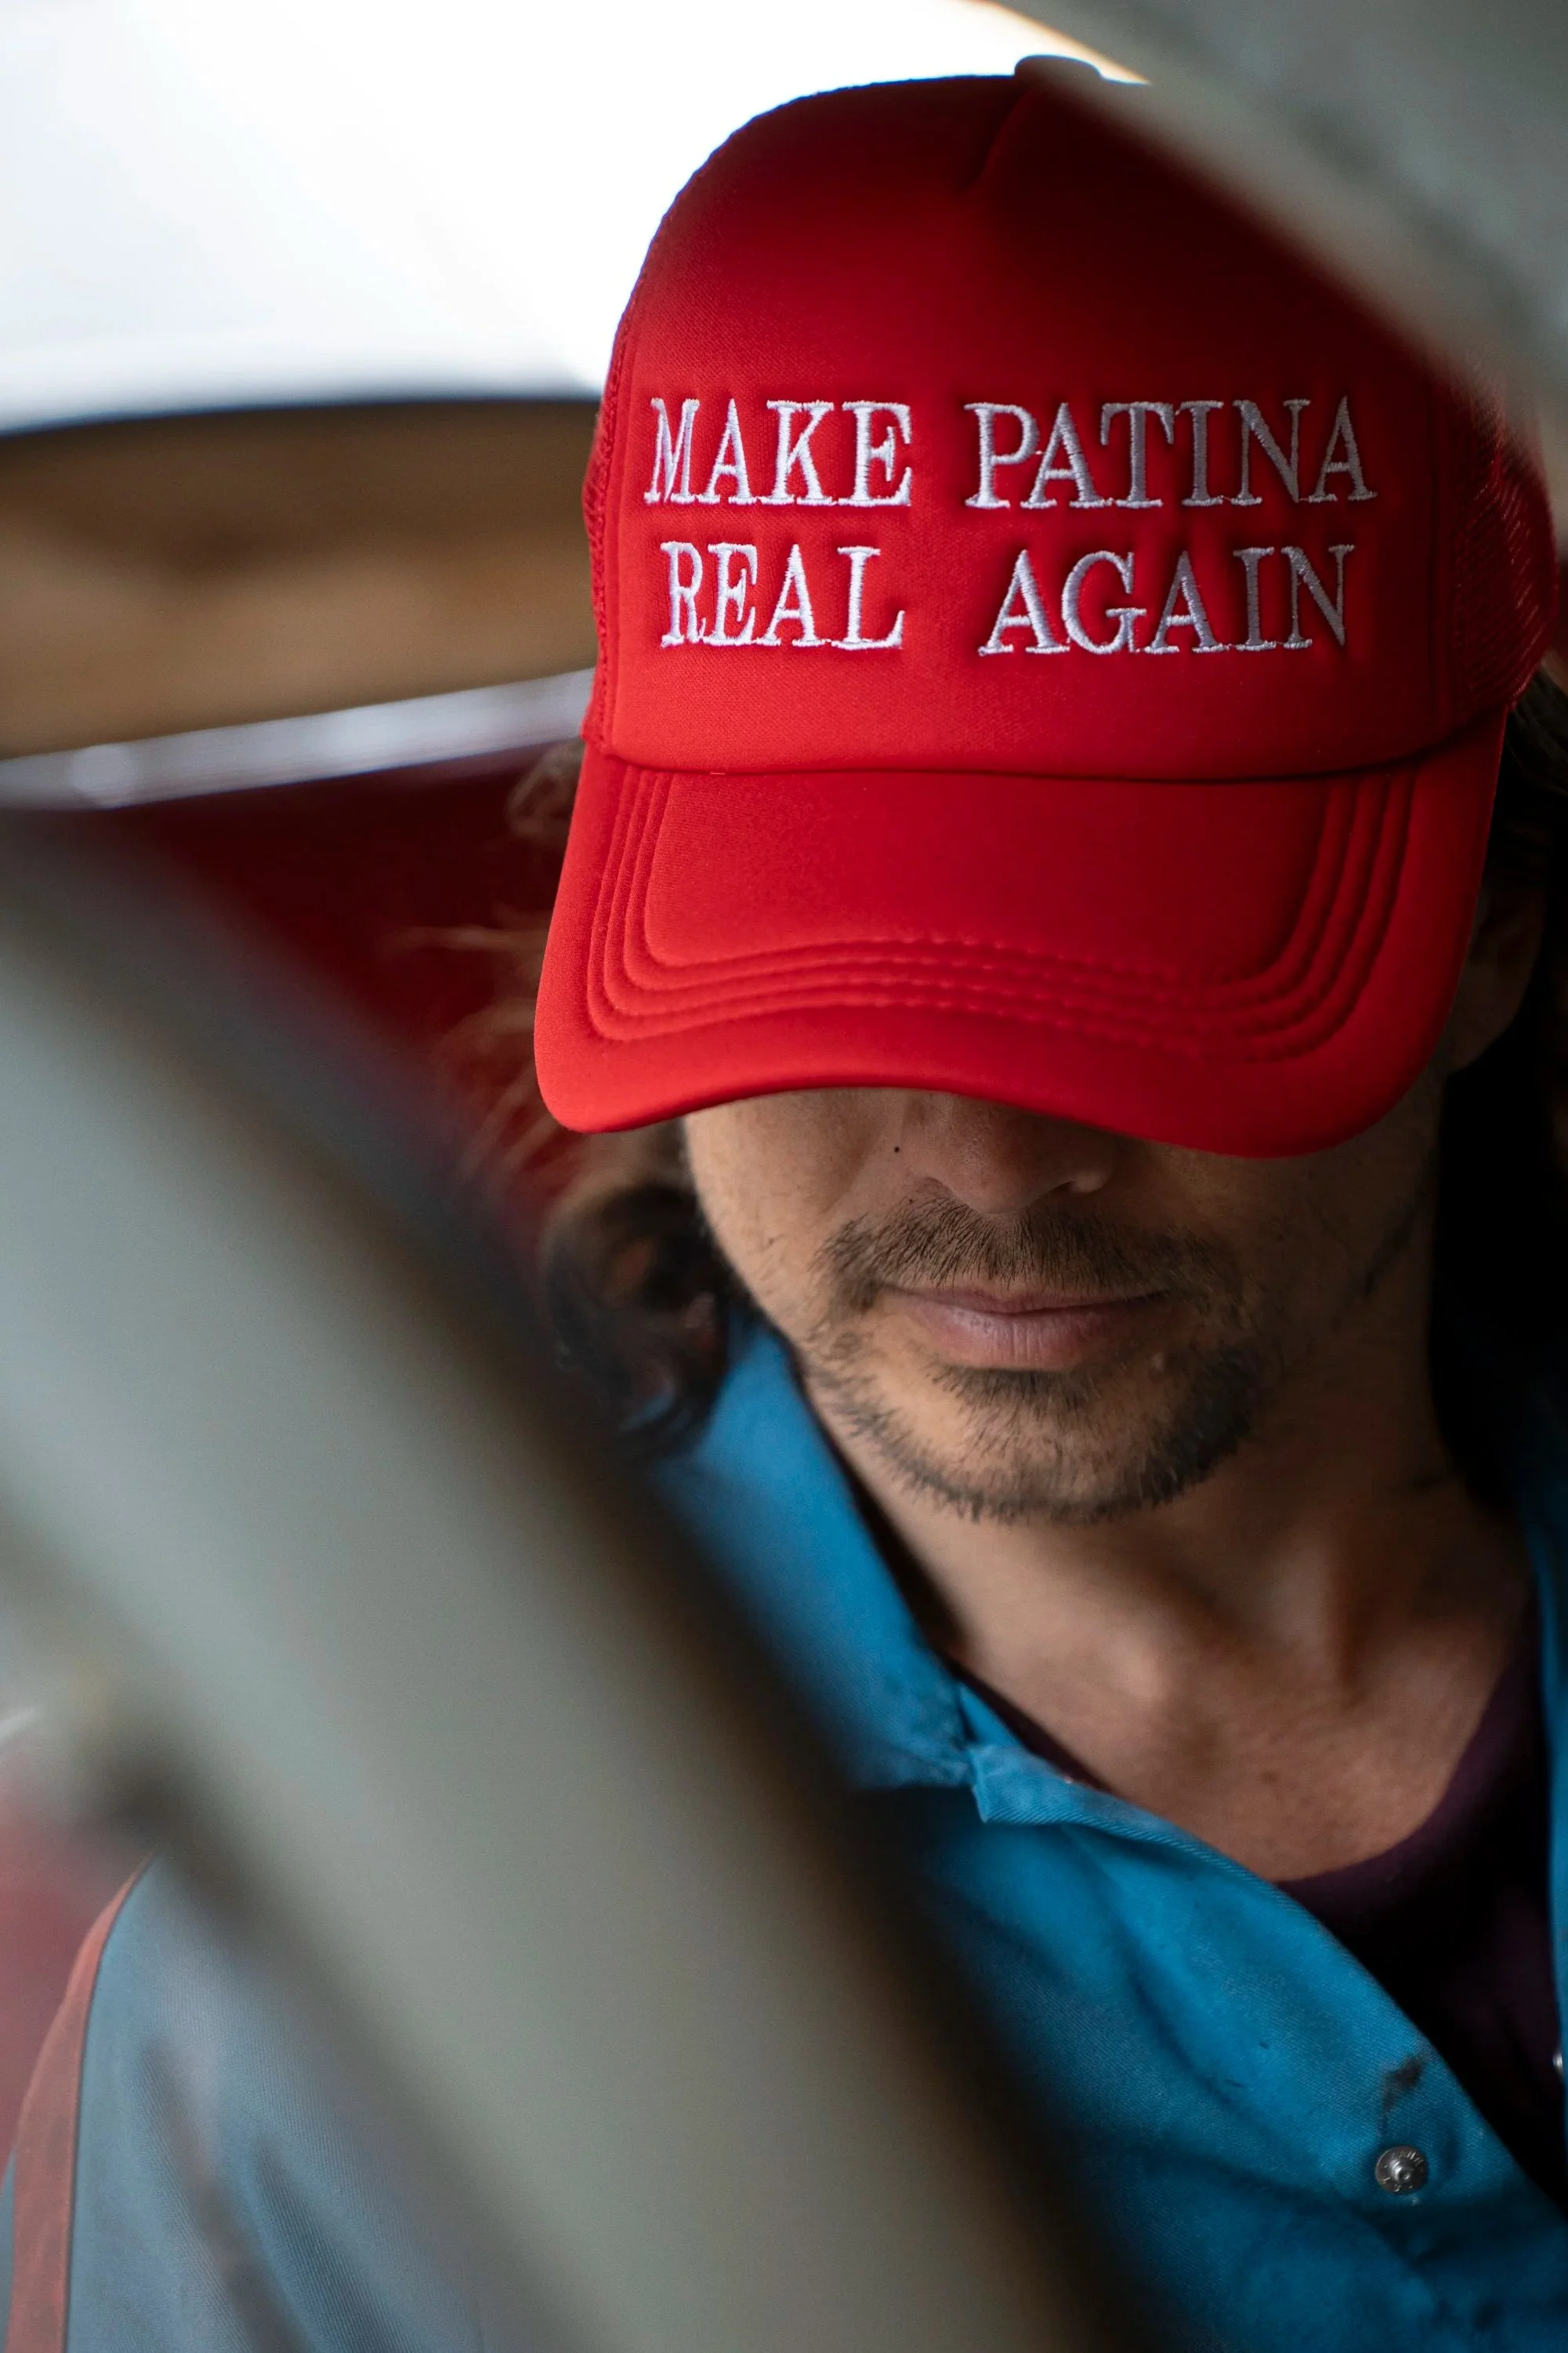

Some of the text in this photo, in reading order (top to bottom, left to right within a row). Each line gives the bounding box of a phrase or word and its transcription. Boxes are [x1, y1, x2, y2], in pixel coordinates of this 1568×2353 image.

[643, 396, 1378, 509] MAKE PATINA
[659, 540, 1357, 657] REAL AGAIN
